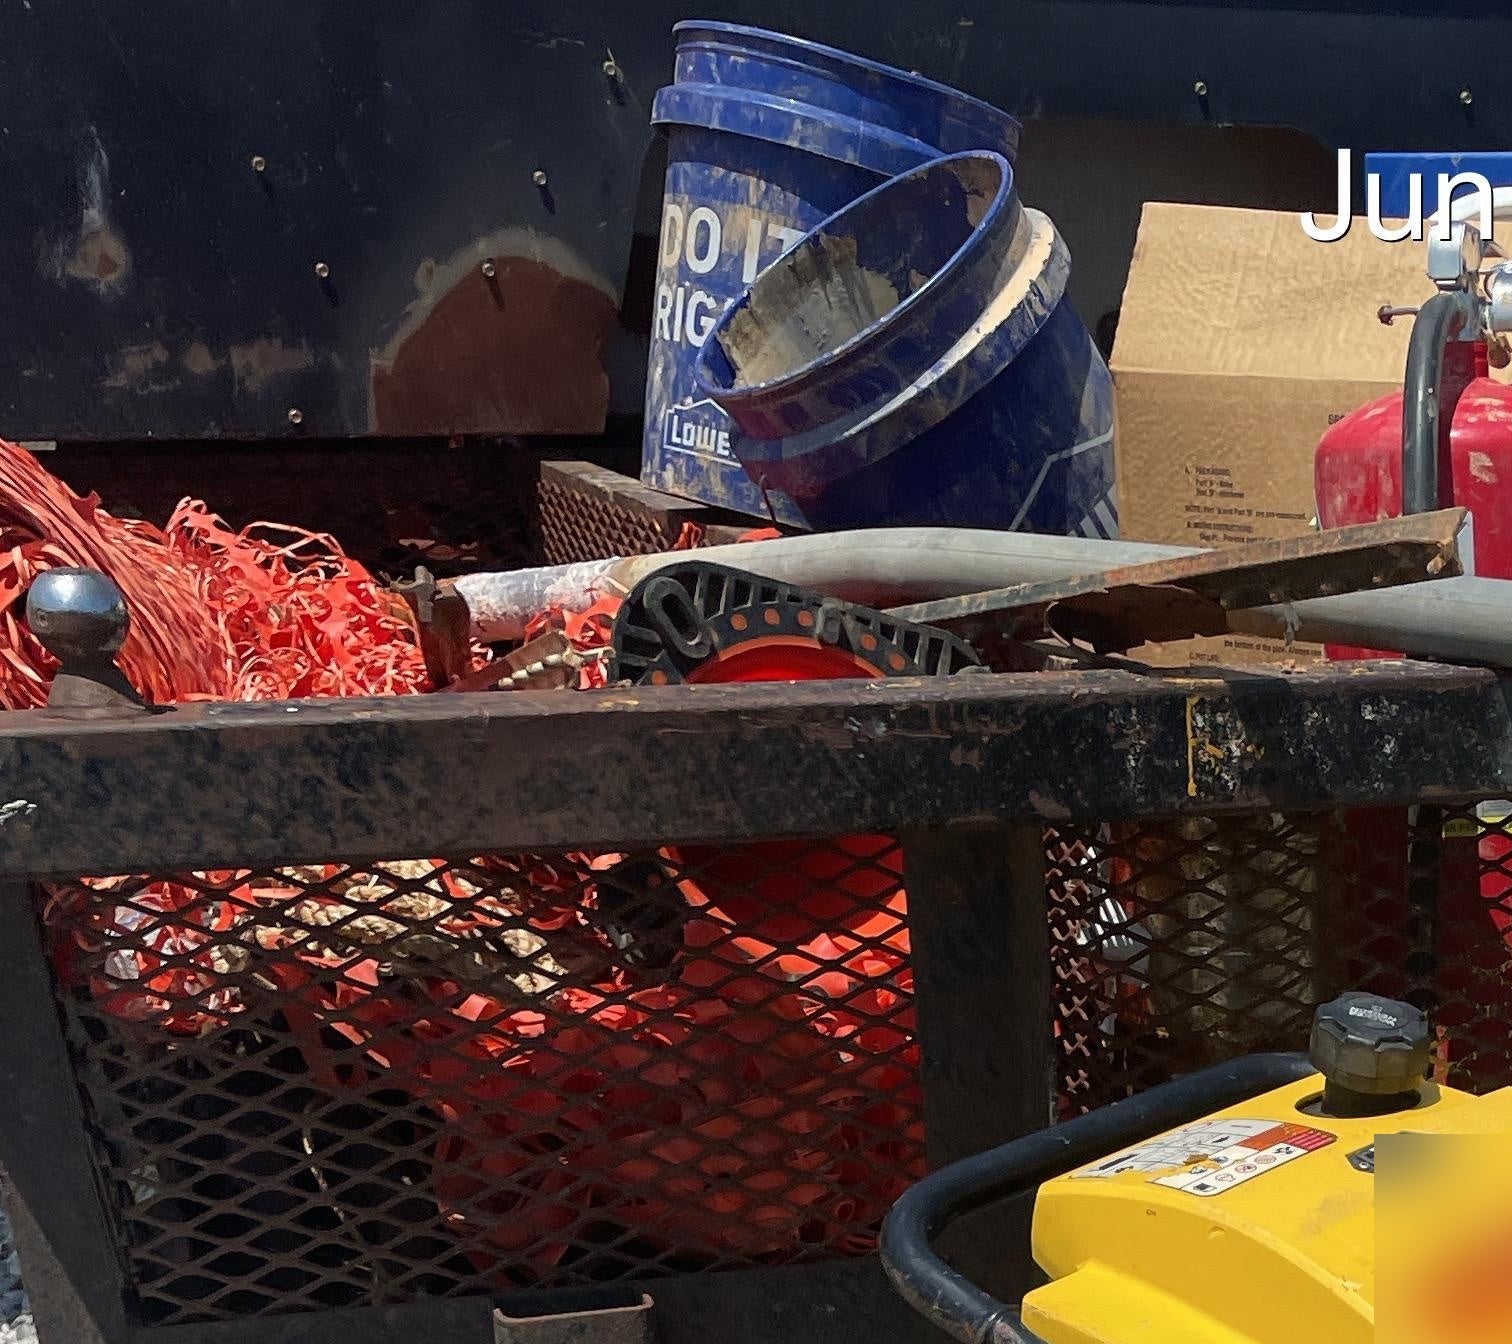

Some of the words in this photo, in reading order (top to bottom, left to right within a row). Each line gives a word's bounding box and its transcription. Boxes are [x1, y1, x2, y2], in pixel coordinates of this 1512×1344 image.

[661, 204, 721, 274] DO
[655, 285, 734, 347] RIG
[671, 414, 736, 457] LOWE
